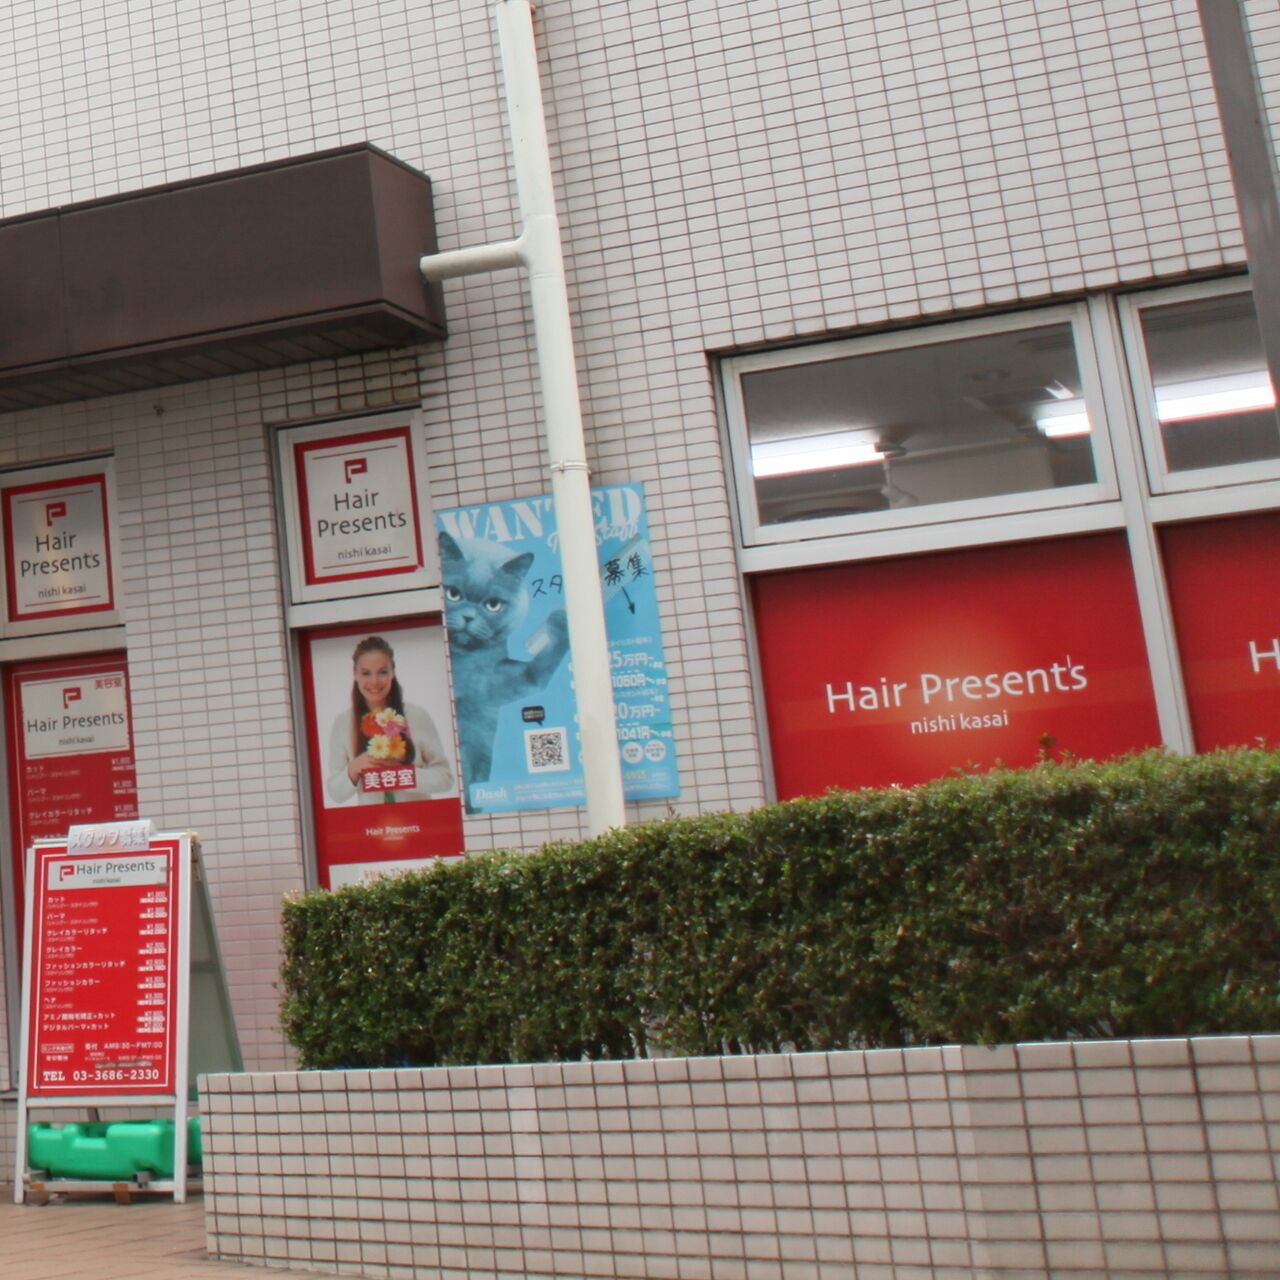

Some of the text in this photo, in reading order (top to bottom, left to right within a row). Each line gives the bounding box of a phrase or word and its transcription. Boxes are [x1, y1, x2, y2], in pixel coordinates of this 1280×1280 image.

[333, 489, 379, 512] Hair
[440, 487, 641, 543] WANED
[36, 531, 76, 552] Hair
[337, 544, 392, 559] nishi kasai
[38, 583, 87, 598] nishi kasai
[825, 676, 907, 713] Hair
[27, 719, 58, 733] Hair
[910, 709, 1008, 734] nishi kasai
[364, 769, 415, 789] 美容室
[365, 827, 384, 836] Hair
[76, 864, 101, 875] Hair
[42, 1069, 160, 1081] TEL 03-3686-2330
